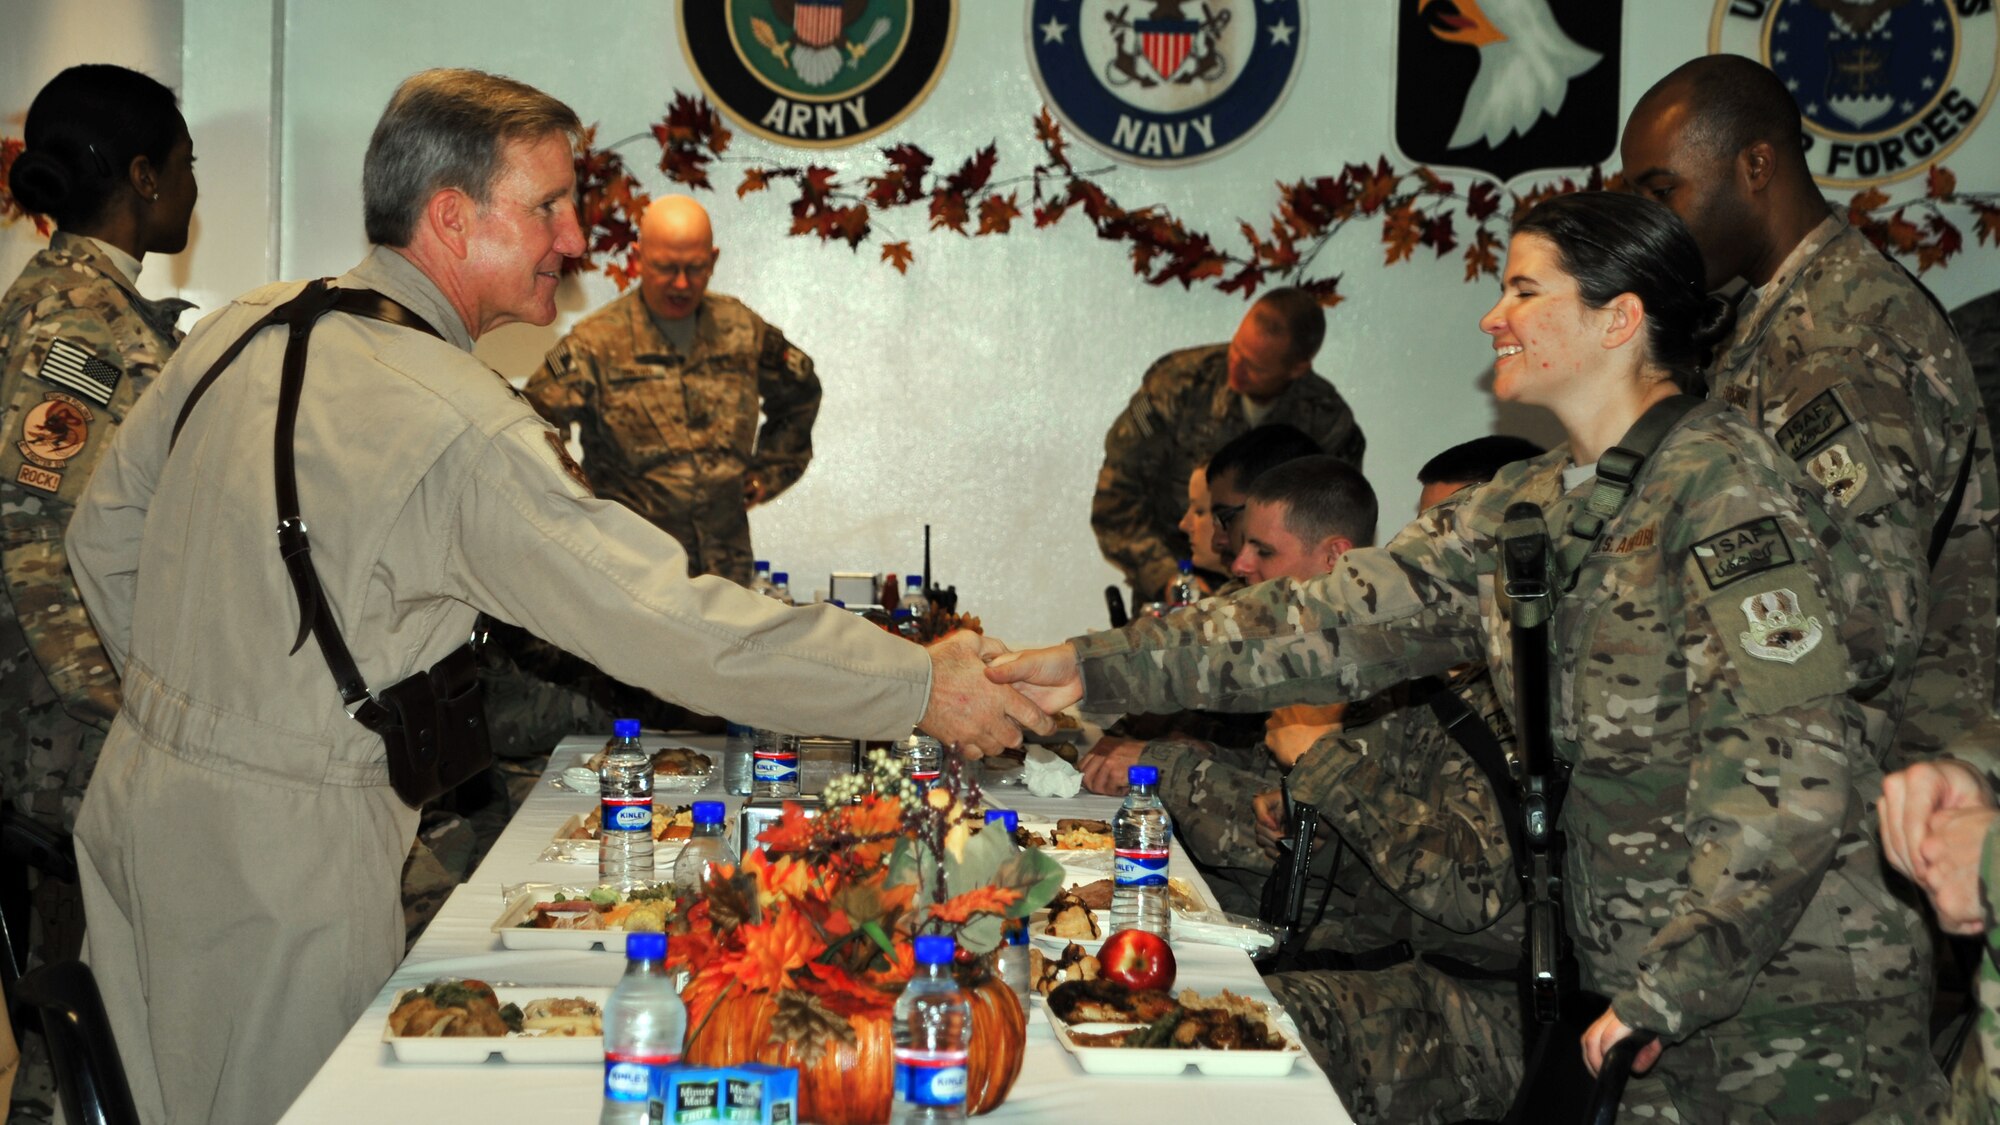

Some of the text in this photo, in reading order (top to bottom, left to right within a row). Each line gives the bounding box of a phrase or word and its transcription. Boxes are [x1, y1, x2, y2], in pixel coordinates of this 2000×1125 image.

[760, 97, 872, 138] ARMY
[1112, 114, 1216, 156] NAVY
[1826, 87, 1978, 177] FORCES
[1787, 403, 1823, 439] ISAF
[19, 467, 58, 489] ROCK!
[1710, 527, 1762, 558] ISAF
[620, 811, 646, 819] KINLEY
[680, 1086, 714, 1097] Minute
[937, 1075, 965, 1087] KINLE
[684, 1096, 708, 1106] Maid
